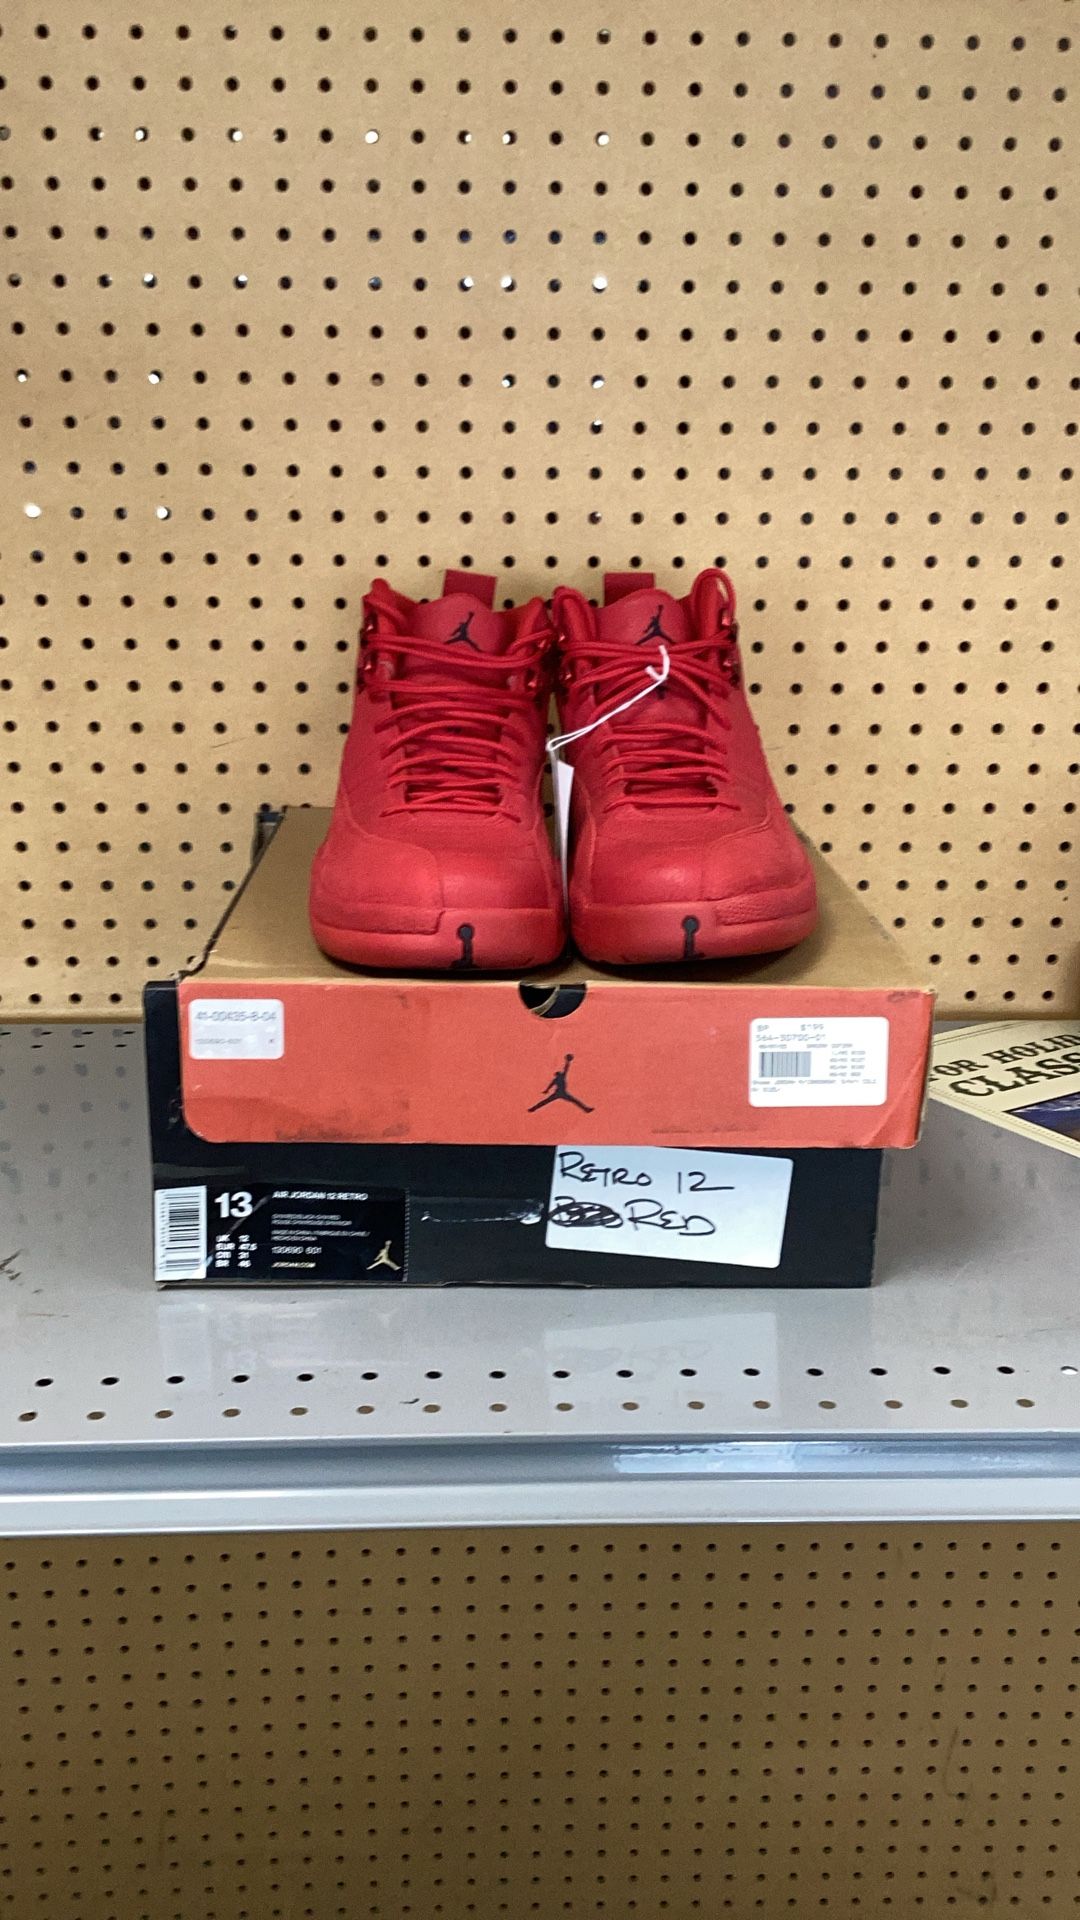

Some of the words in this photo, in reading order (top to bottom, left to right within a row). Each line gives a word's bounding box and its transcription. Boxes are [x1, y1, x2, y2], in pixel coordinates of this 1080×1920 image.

[929, 1059, 989, 1082] OR
[558, 1150, 653, 1187] RETRO
[677, 1171, 735, 1194] 12
[214, 1191, 253, 1218] 13
[272, 1190, 288, 1199] AIR
[289, 1190, 326, 1200] JORDAN
[336, 1192, 369, 1201] RETRO
[624, 1198, 716, 1236] RED
[215, 1242, 236, 1251] EUR
[238, 1234, 250, 1242] 12
